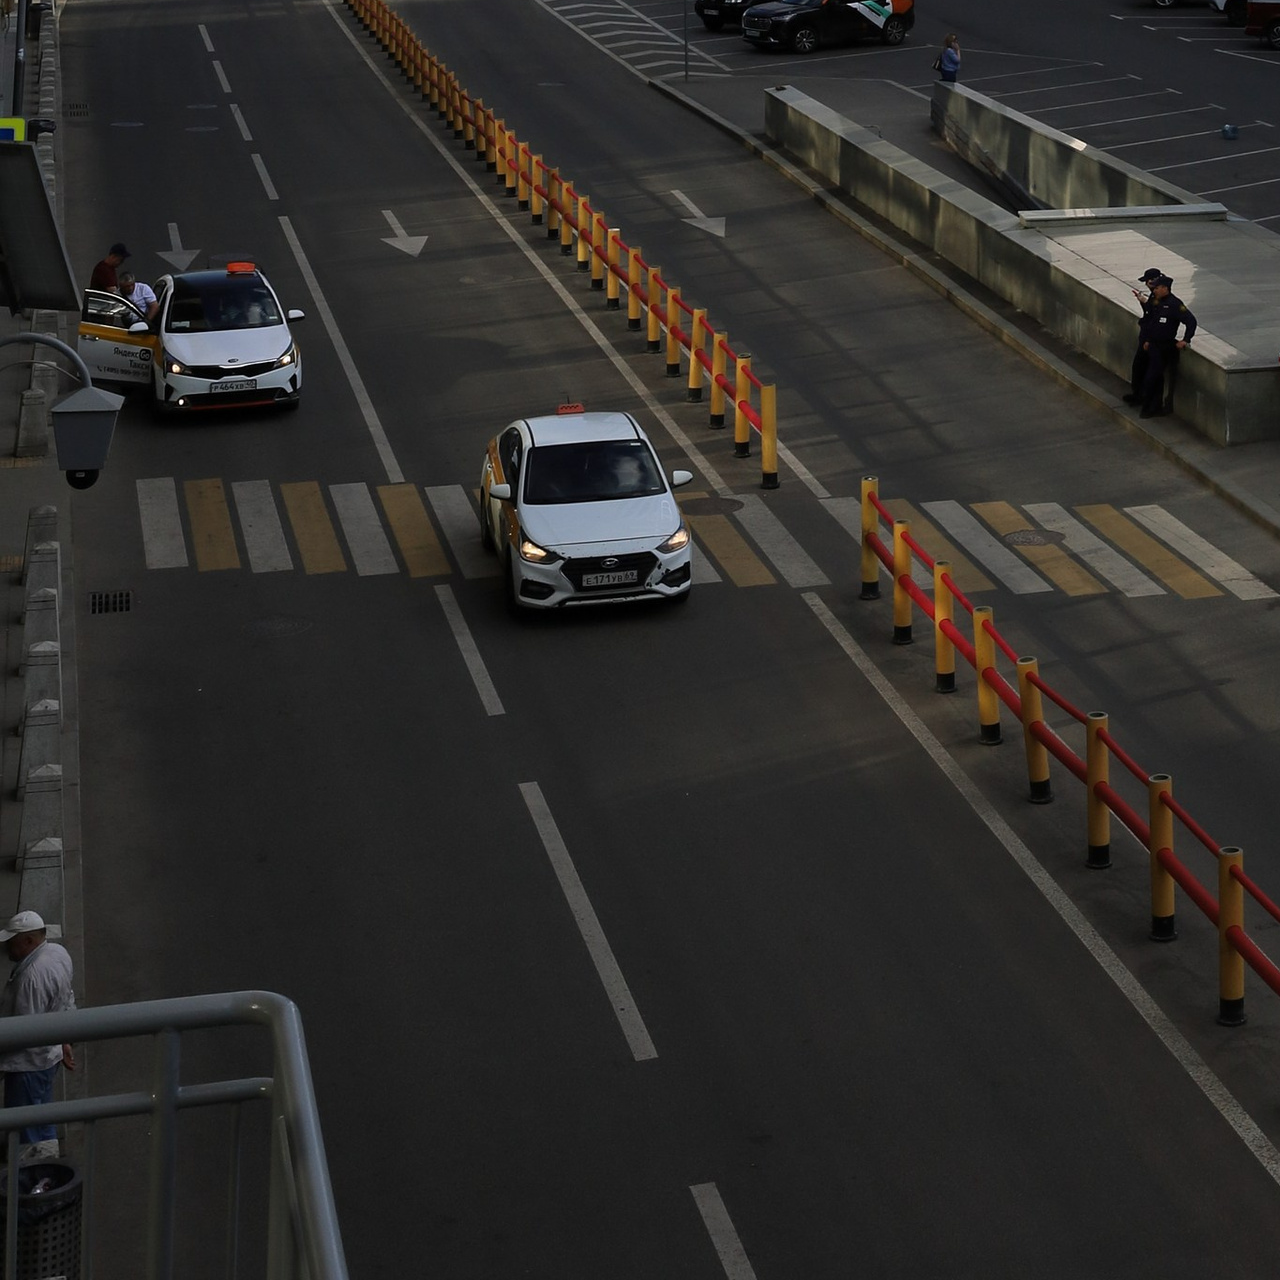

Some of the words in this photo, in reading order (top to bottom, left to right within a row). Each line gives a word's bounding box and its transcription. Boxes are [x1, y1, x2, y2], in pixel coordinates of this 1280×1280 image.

[113, 347, 140, 359] Яндекс
[129, 359, 150, 369] Такси
[586, 574, 623, 586] Е171УВ
